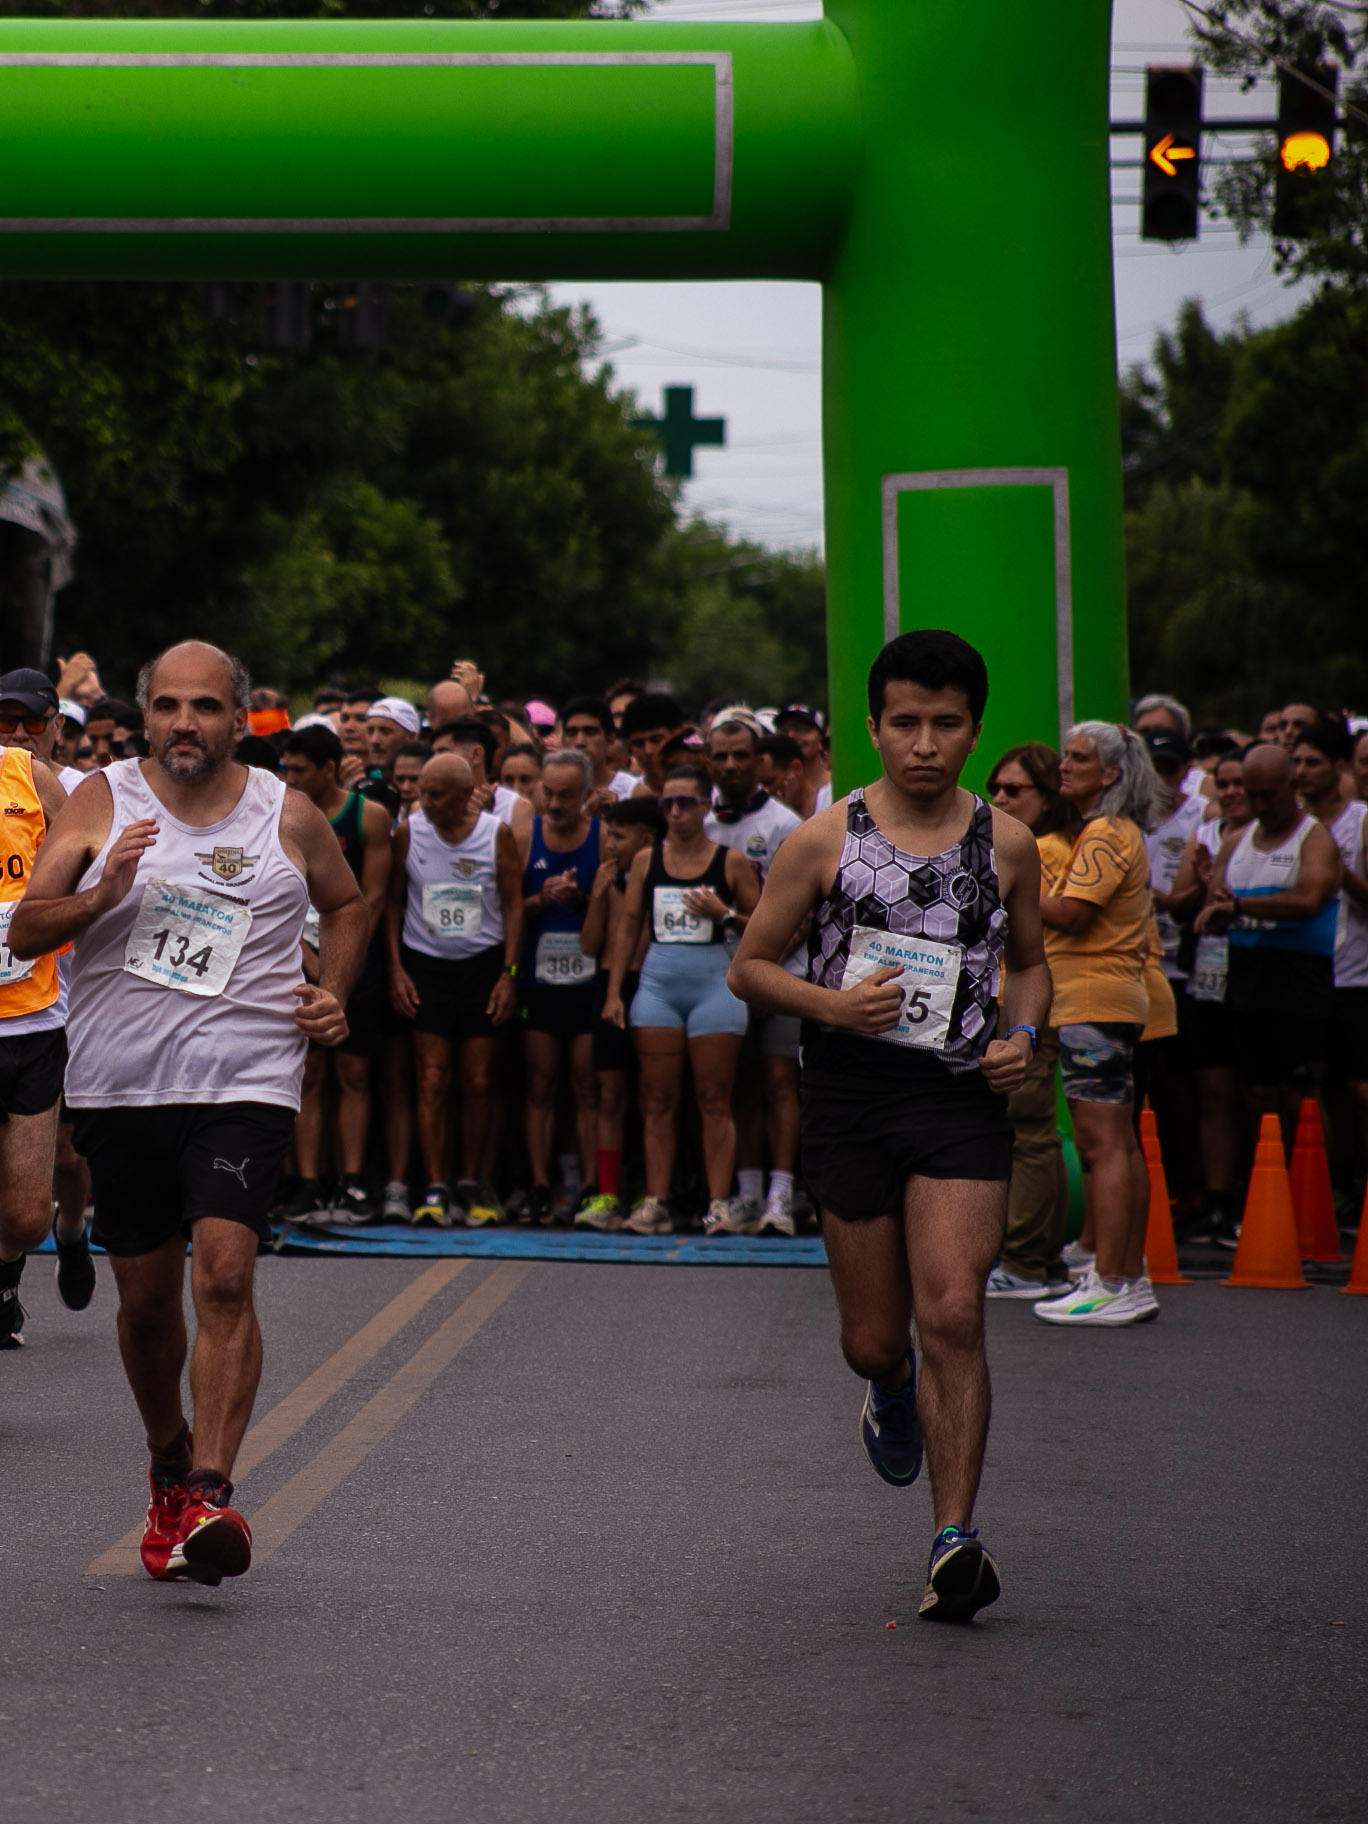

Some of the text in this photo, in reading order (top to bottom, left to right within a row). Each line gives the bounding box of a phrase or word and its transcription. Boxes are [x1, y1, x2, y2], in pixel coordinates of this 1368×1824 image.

[219, 864, 236, 873] 40
[161, 894, 175, 904] 40
[178, 897, 234, 924] MARATON
[440, 909, 464, 926] 86
[152, 929, 213, 977] 134
[869, 941, 944, 966] 40 MARATON
[903, 964, 944, 978] GRANEROS
